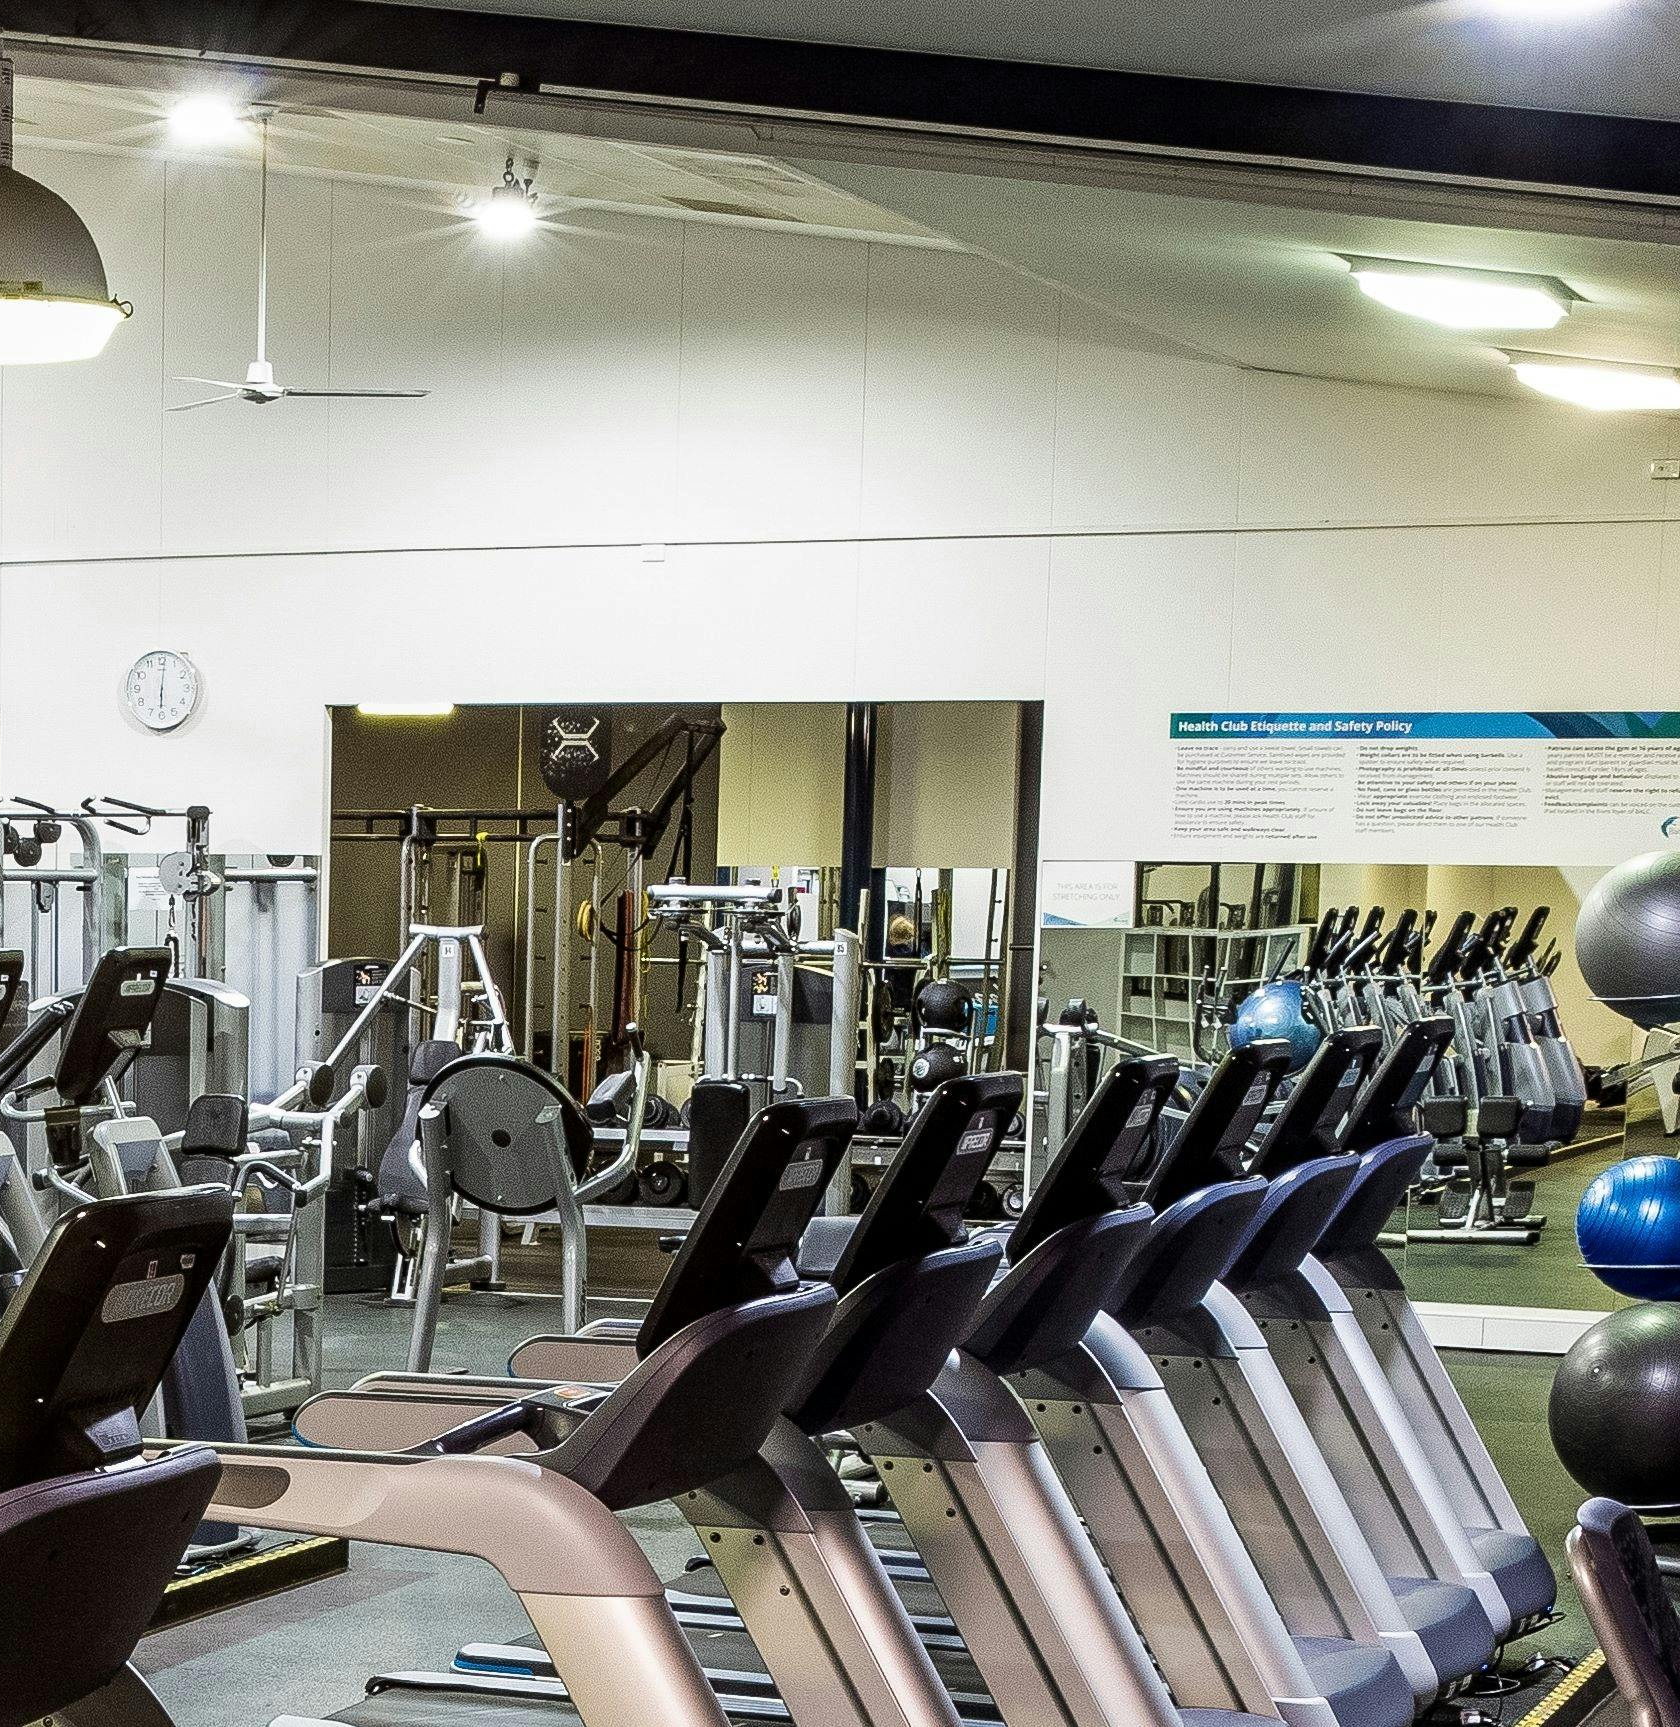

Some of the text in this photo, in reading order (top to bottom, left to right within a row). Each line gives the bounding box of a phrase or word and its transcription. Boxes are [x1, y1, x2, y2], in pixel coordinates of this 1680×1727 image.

[1177, 720, 1412, 734] Health Club Etiquette and Safety Policy
